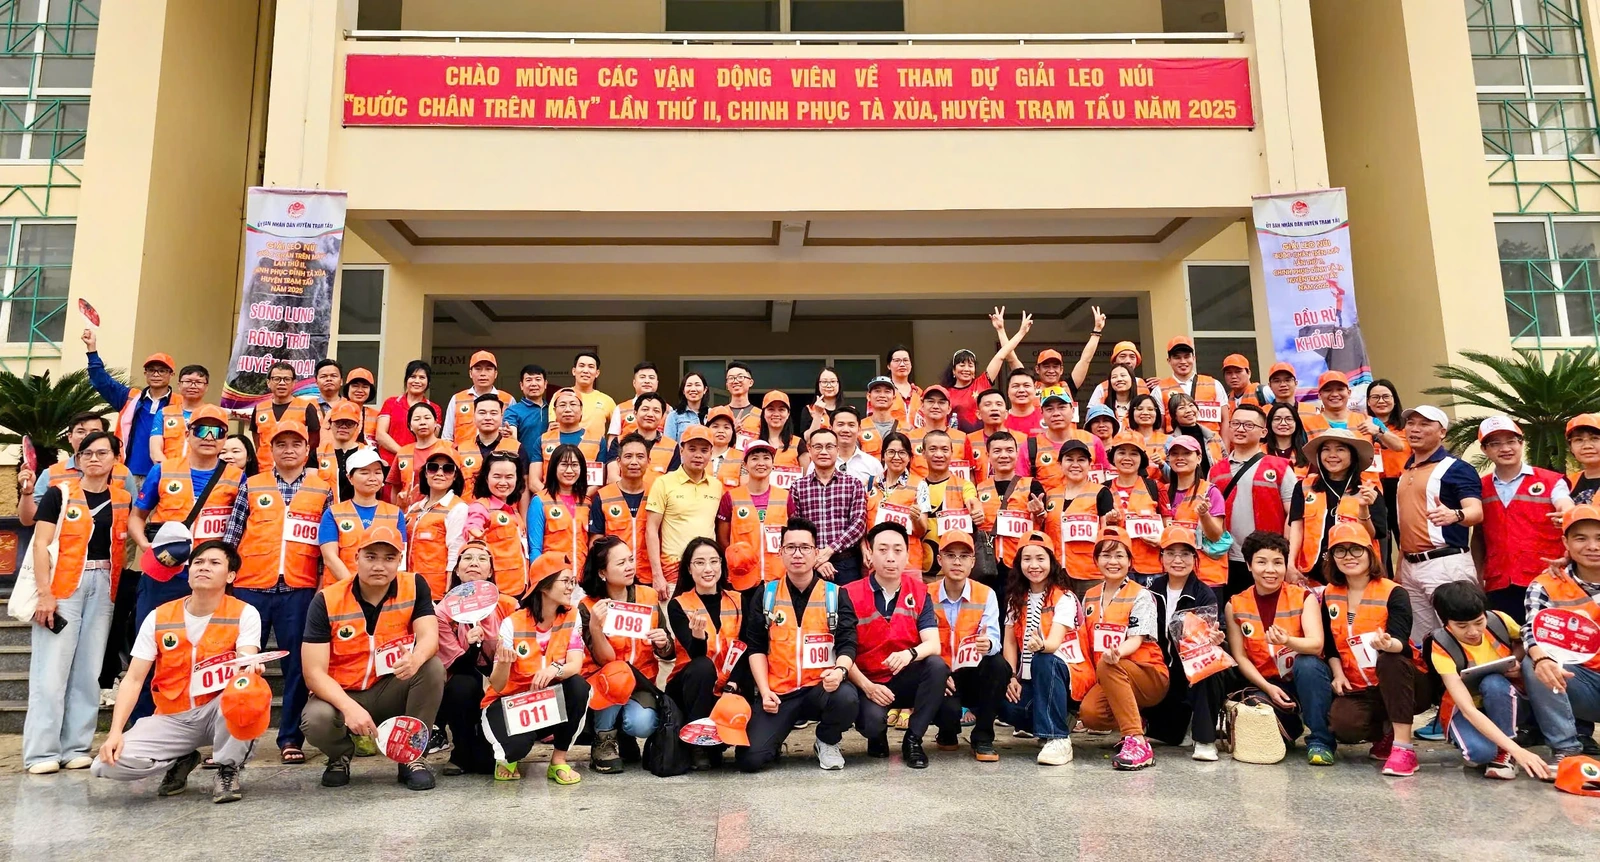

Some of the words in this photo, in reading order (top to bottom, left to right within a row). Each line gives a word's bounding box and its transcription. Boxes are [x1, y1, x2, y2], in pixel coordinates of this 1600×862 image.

[445, 64, 500, 87] CHÀO
[516, 63, 578, 88] MỪNG
[598, 64, 638, 88] CÁC
[654, 64, 695, 91] VẬN
[716, 64, 772, 91] ĐỘNG
[791, 64, 836, 88] VIÊN
[855, 63, 879, 88] VỀ
[897, 68, 953, 88] THAM
[971, 66, 1000, 92] DỰ
[1015, 61, 1055, 88] GIẢI
[1068, 68, 1104, 88] LEO
[1119, 64, 1154, 88] NÚI
[418, 95, 474, 118] CHÂN
[484, 95, 535, 119] TRÊN
[610, 93, 648, 120] LẦN
[656, 95, 697, 120] THỨ
[704, 101, 722, 123] II,
[728, 101, 789, 120] CHINH
[797, 101, 850, 124] PHỤC
[860, 96, 885, 120] TÀ
[893, 97, 938, 124] XÙA,
[942, 98, 1004, 125] HUYỆN
[1016, 100, 1074, 124] TRẠM
[1085, 94, 1126, 120] TẤU
[1135, 95, 1181, 120] NĂM
[1188, 100, 1237, 119] 2025
[250, 300, 284, 322] SỐNG
[1294, 307, 1319, 328] ĐẦU
[248, 326, 284, 348] RỒNG
[286, 331, 311, 349] TRỜI
[236, 353, 280, 374] HUYỀ
[432, 355, 466, 367] TRẠM
[1200, 408, 1217, 418] 008
[204, 520, 226, 534] 005
[292, 524, 318, 540] 009
[944, 517, 966, 530] 020
[1008, 520, 1028, 534] 100
[1070, 524, 1092, 537] 050
[1134, 522, 1159, 535] 004
[614, 614, 643, 633] 098
[810, 646, 828, 664] 090
[958, 648, 980, 664] 073
[519, 704, 548, 727] 011
